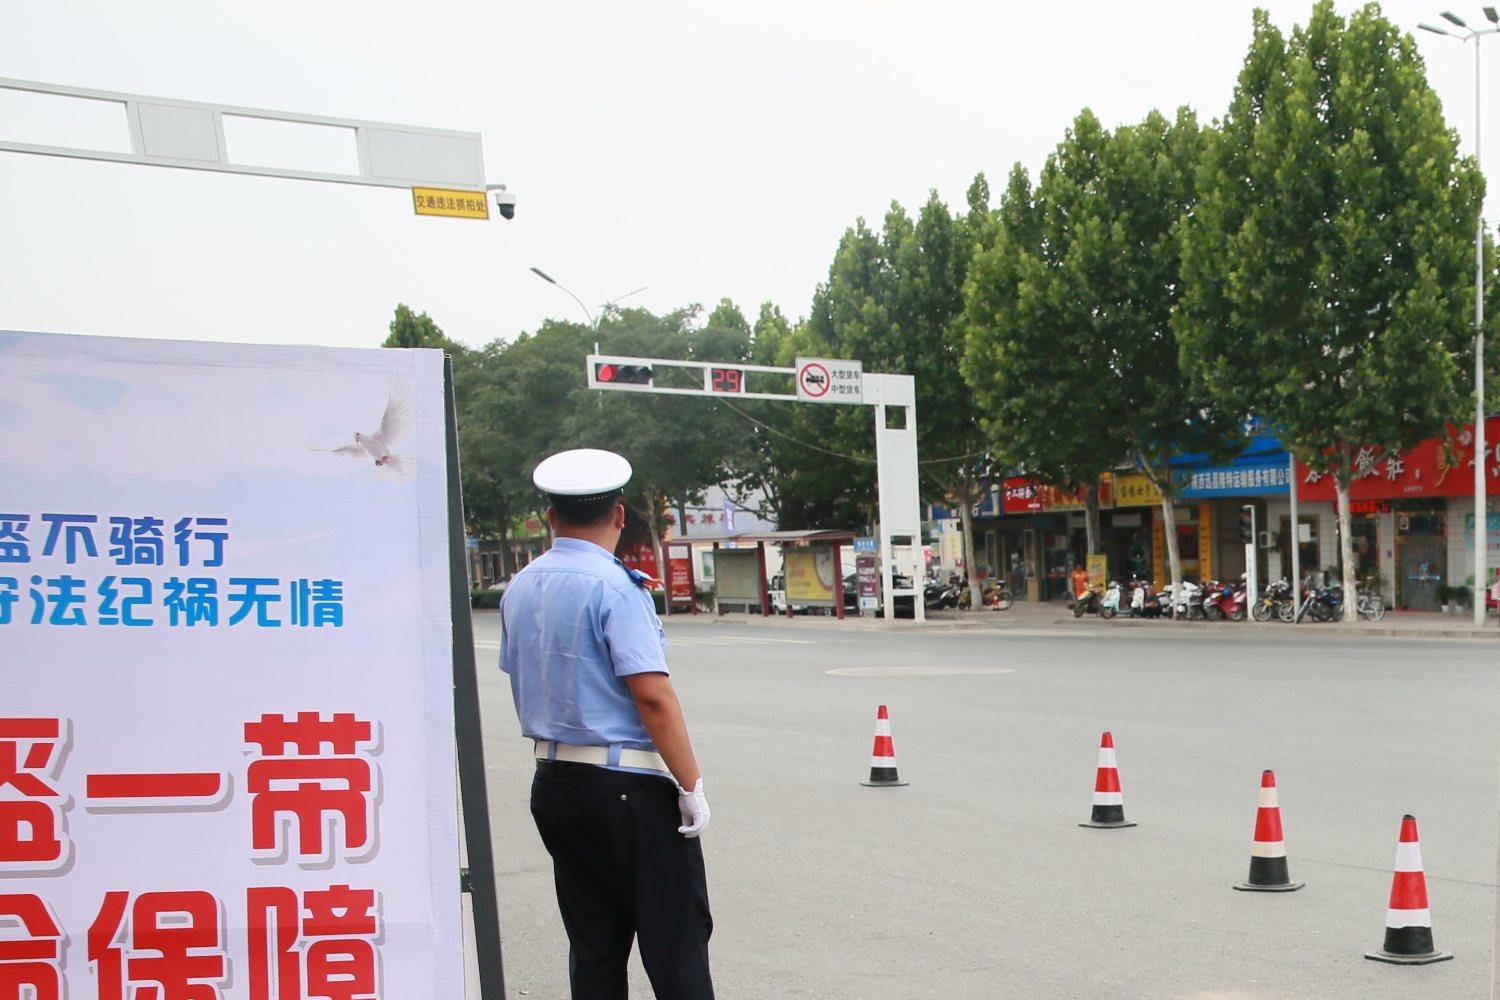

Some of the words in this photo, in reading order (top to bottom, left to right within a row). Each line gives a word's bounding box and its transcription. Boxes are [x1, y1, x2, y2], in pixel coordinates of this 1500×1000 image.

[415, 195, 486, 213] 交通违法抓拍处
[712, 368, 741, 393] 29
[831, 369, 860, 380] 大型货车
[831, 384, 861, 394] 中型货车
